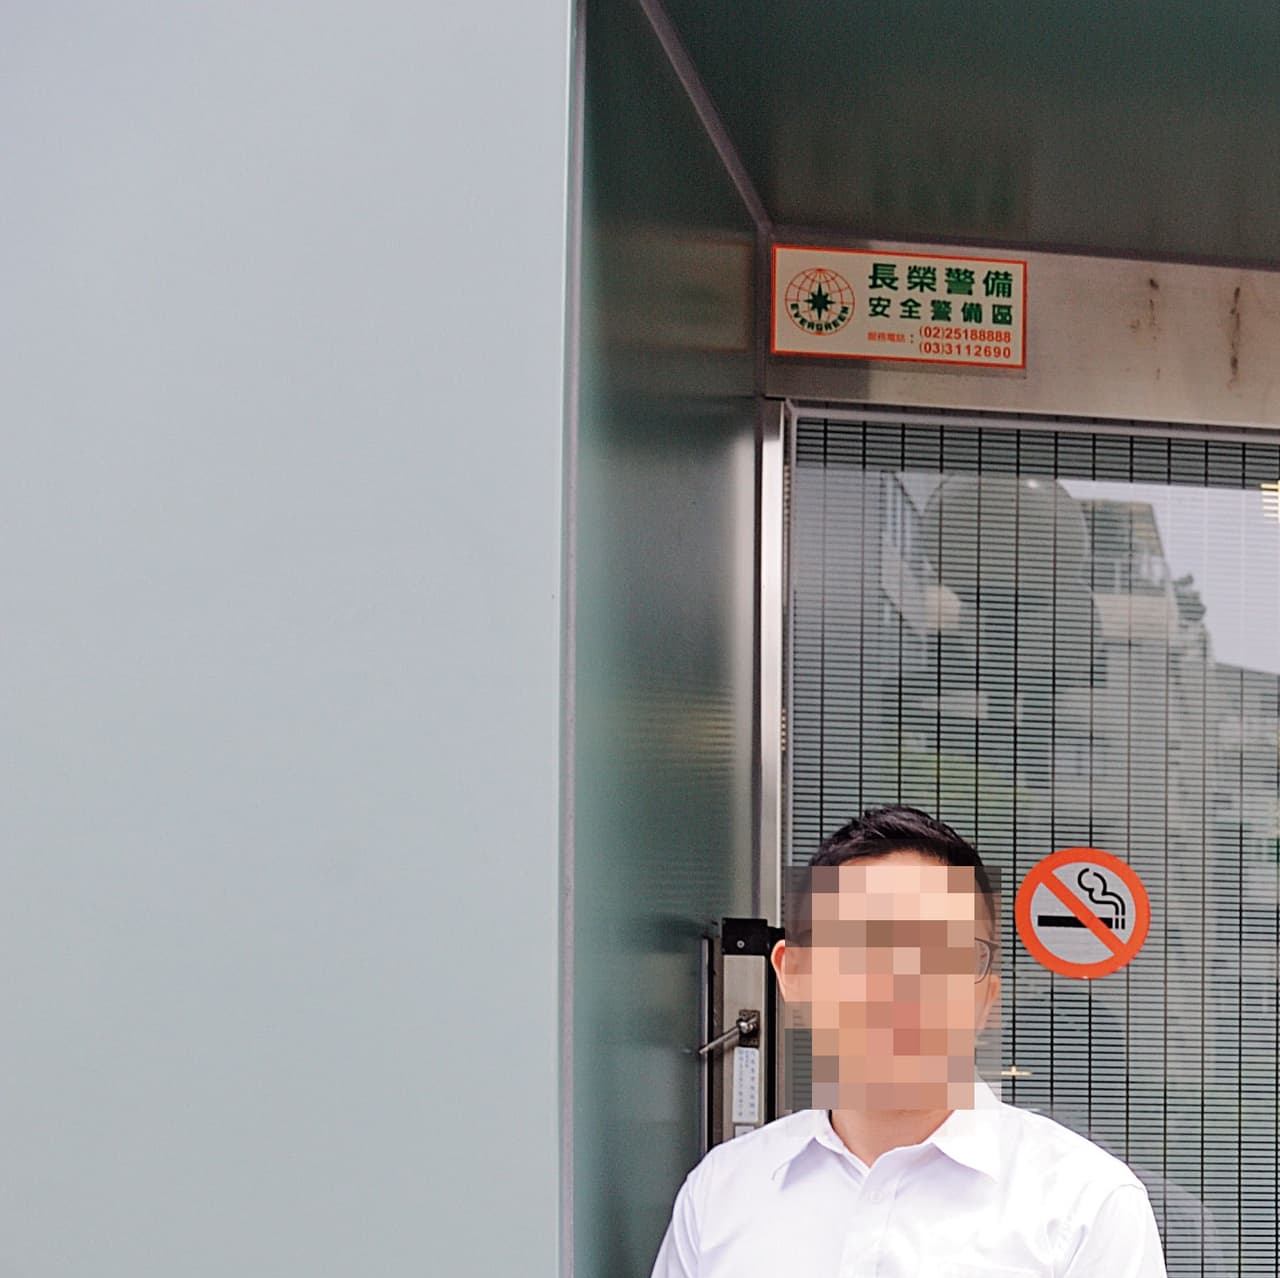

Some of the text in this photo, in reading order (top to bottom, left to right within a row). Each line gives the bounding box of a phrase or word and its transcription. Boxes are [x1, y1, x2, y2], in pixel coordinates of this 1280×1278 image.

[868, 263, 1013, 298] 長榮警備
[790, 303, 849, 331] EVERGREEN
[868, 296, 1013, 325] 安全警備區
[919, 326, 1012, 343] (02)25188888
[919, 341, 1012, 359] (03)3112690
